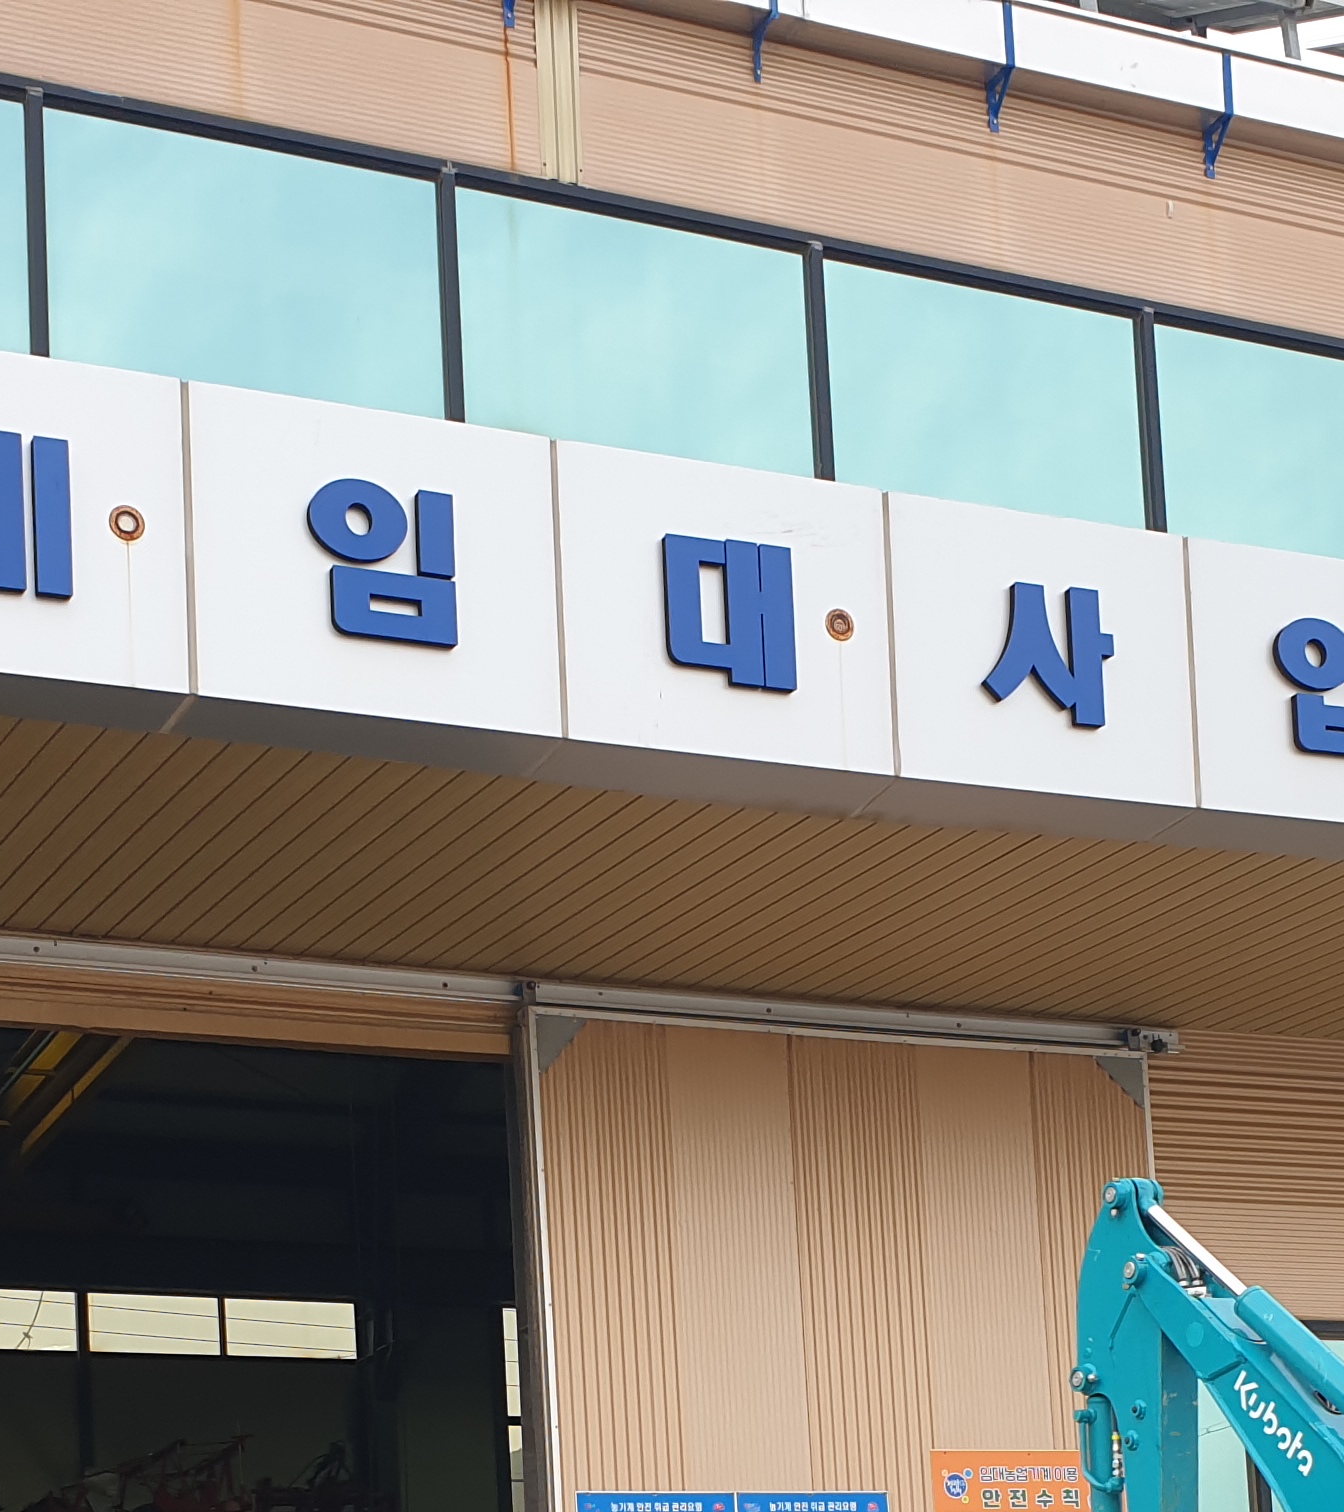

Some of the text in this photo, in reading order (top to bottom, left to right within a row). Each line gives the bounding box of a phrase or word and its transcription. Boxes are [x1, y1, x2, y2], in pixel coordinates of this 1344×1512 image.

[1233, 1370, 1314, 1477] Kubota
[980, 1466, 1078, 1482] 임대농업기계 이용
[610, 1502, 634, 1512] 농기계
[637, 1502, 652, 1512] 안전
[654, 1502, 669, 1512] 취급
[770, 1501, 792, 1512] 농기계
[794, 1501, 808, 1512] 안전
[811, 1501, 825, 1512] 취급
